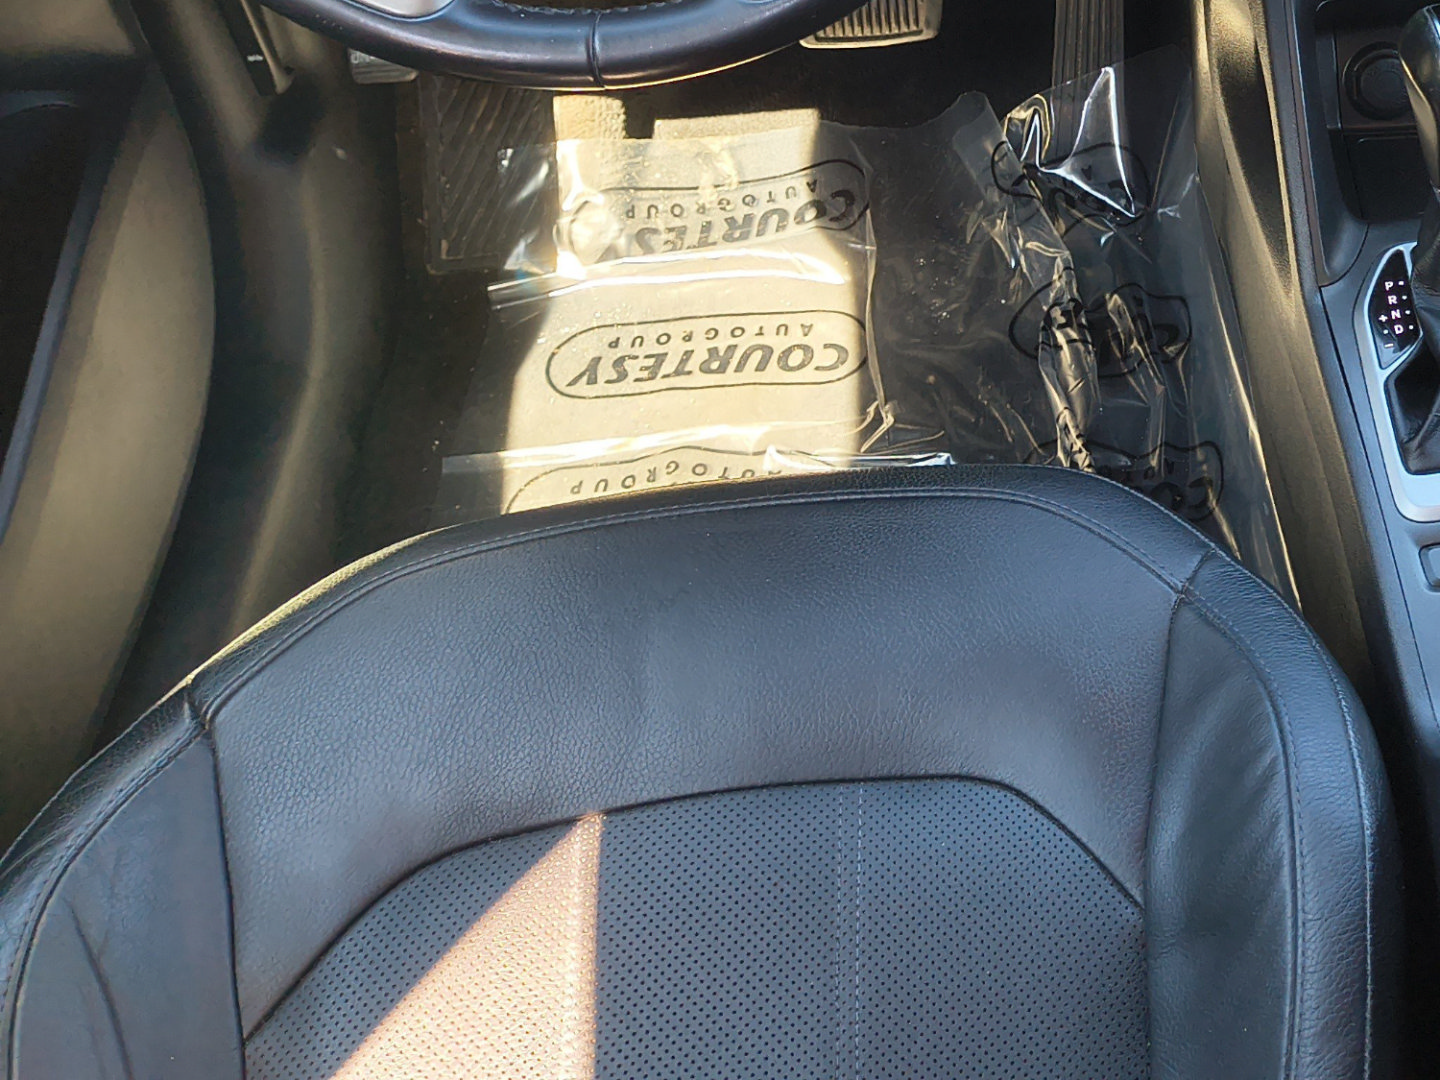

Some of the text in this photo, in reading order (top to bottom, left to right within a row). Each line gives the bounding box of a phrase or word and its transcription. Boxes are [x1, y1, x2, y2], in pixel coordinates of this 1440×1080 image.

[625, 179, 818, 220] AUTOGROUP
[594, 189, 855, 264] COURTES
[1385, 281, 1393, 291] P
[1388, 295, 1397, 305] R
[1391, 310, 1401, 320] N
[608, 323, 813, 349] AUTOGROUP
[1394, 325, 1403, 335] D
[565, 343, 848, 387] COURTESY
[569, 459, 784, 496] UTOGROUP
